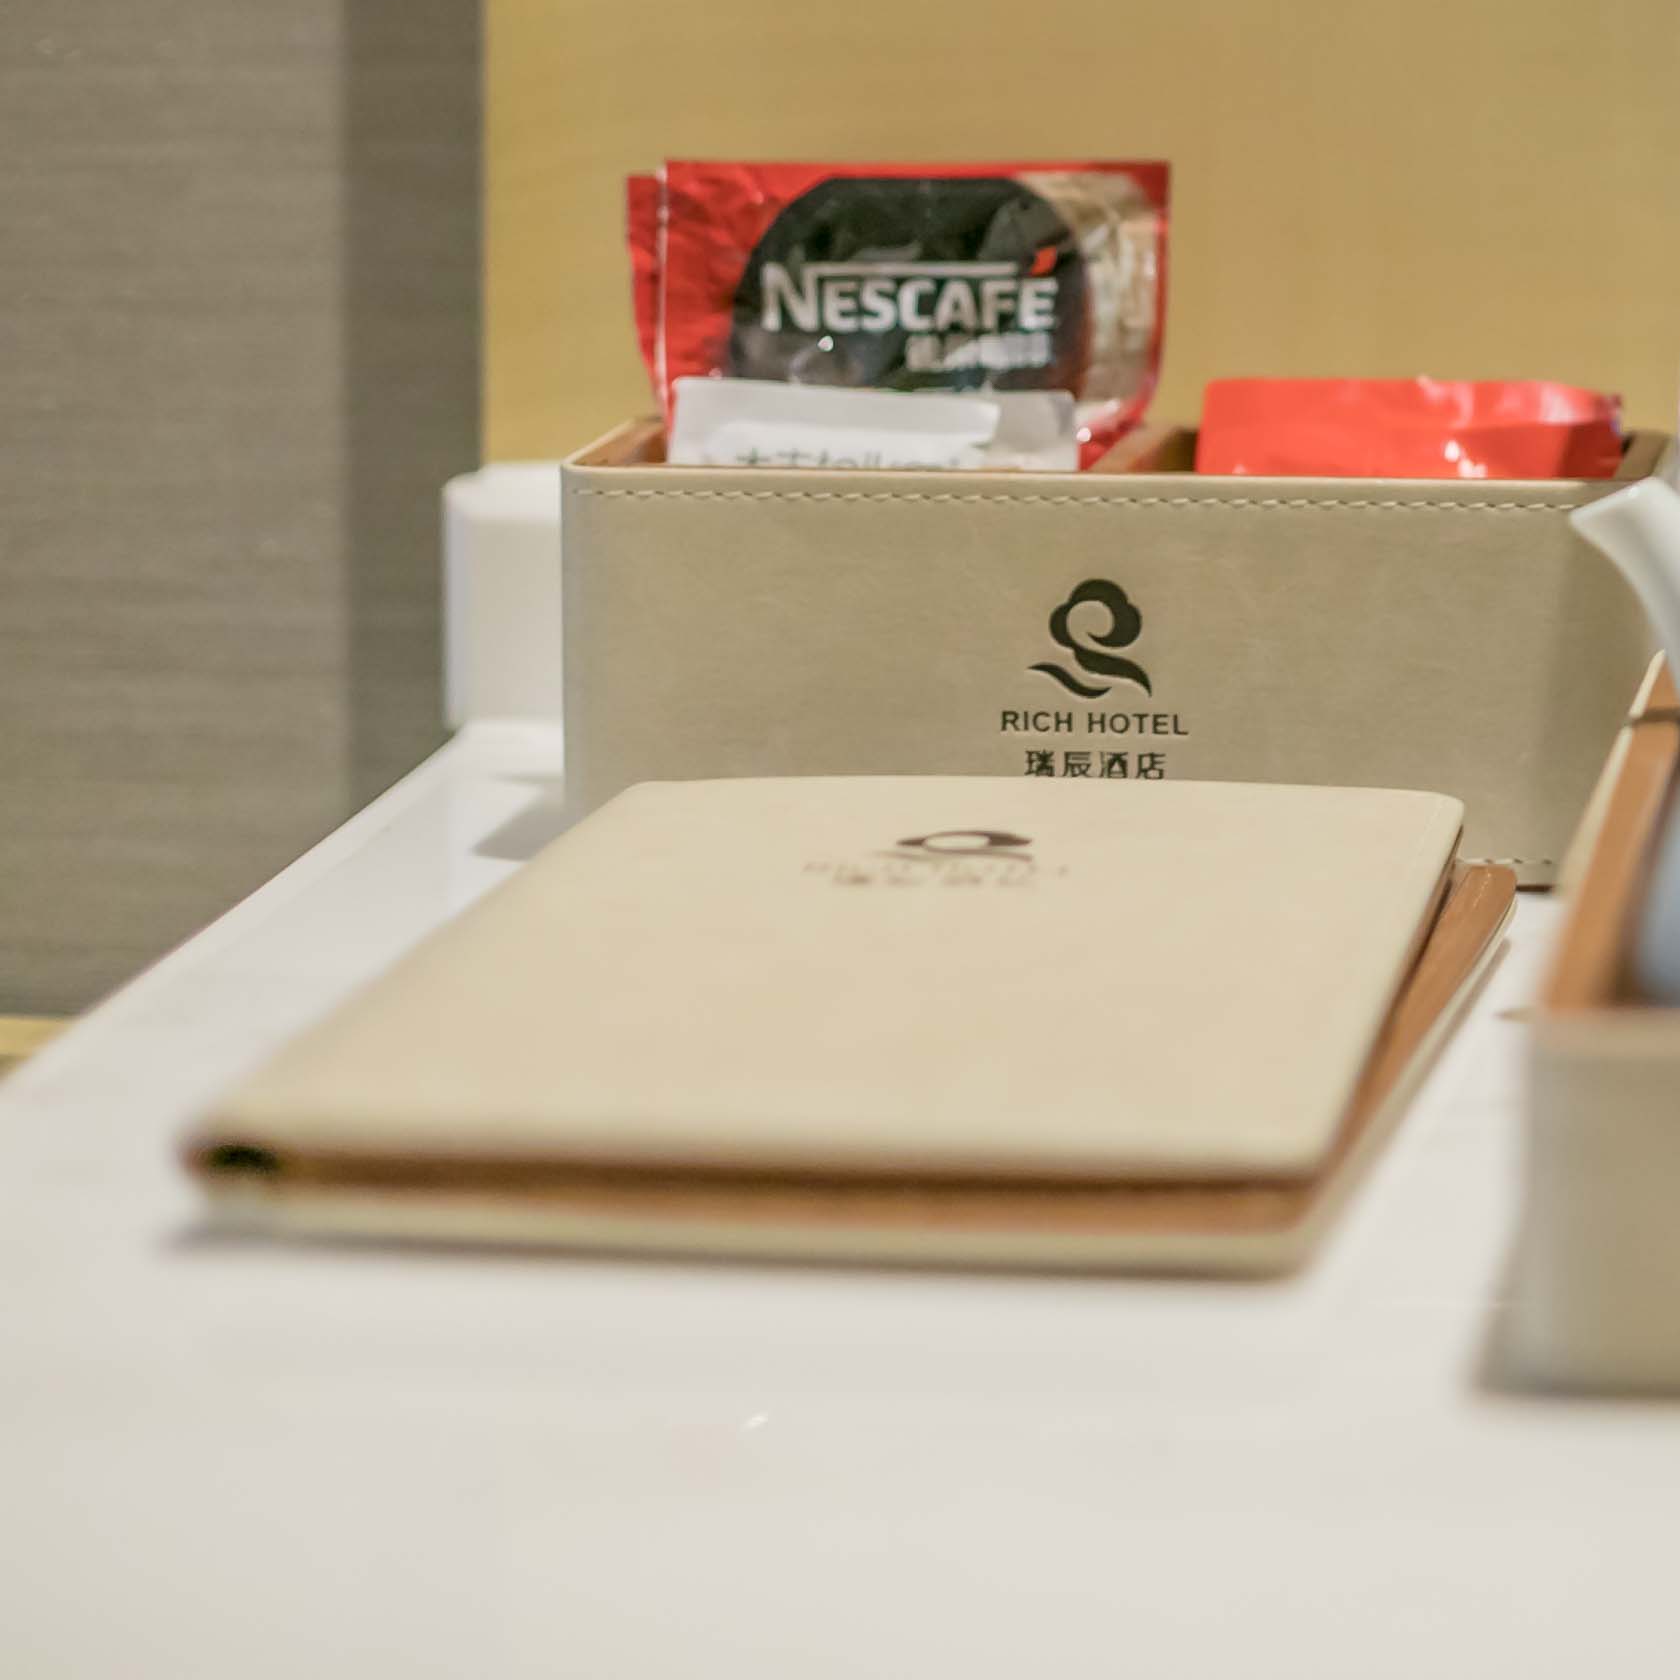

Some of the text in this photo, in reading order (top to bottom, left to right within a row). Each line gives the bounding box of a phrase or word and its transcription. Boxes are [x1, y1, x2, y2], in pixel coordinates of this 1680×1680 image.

[761, 247, 1059, 332] NESCAFÉ
[1000, 710, 1190, 736] RICH HOTEL
[1024, 748, 1168, 781] 瑞辰酒店
